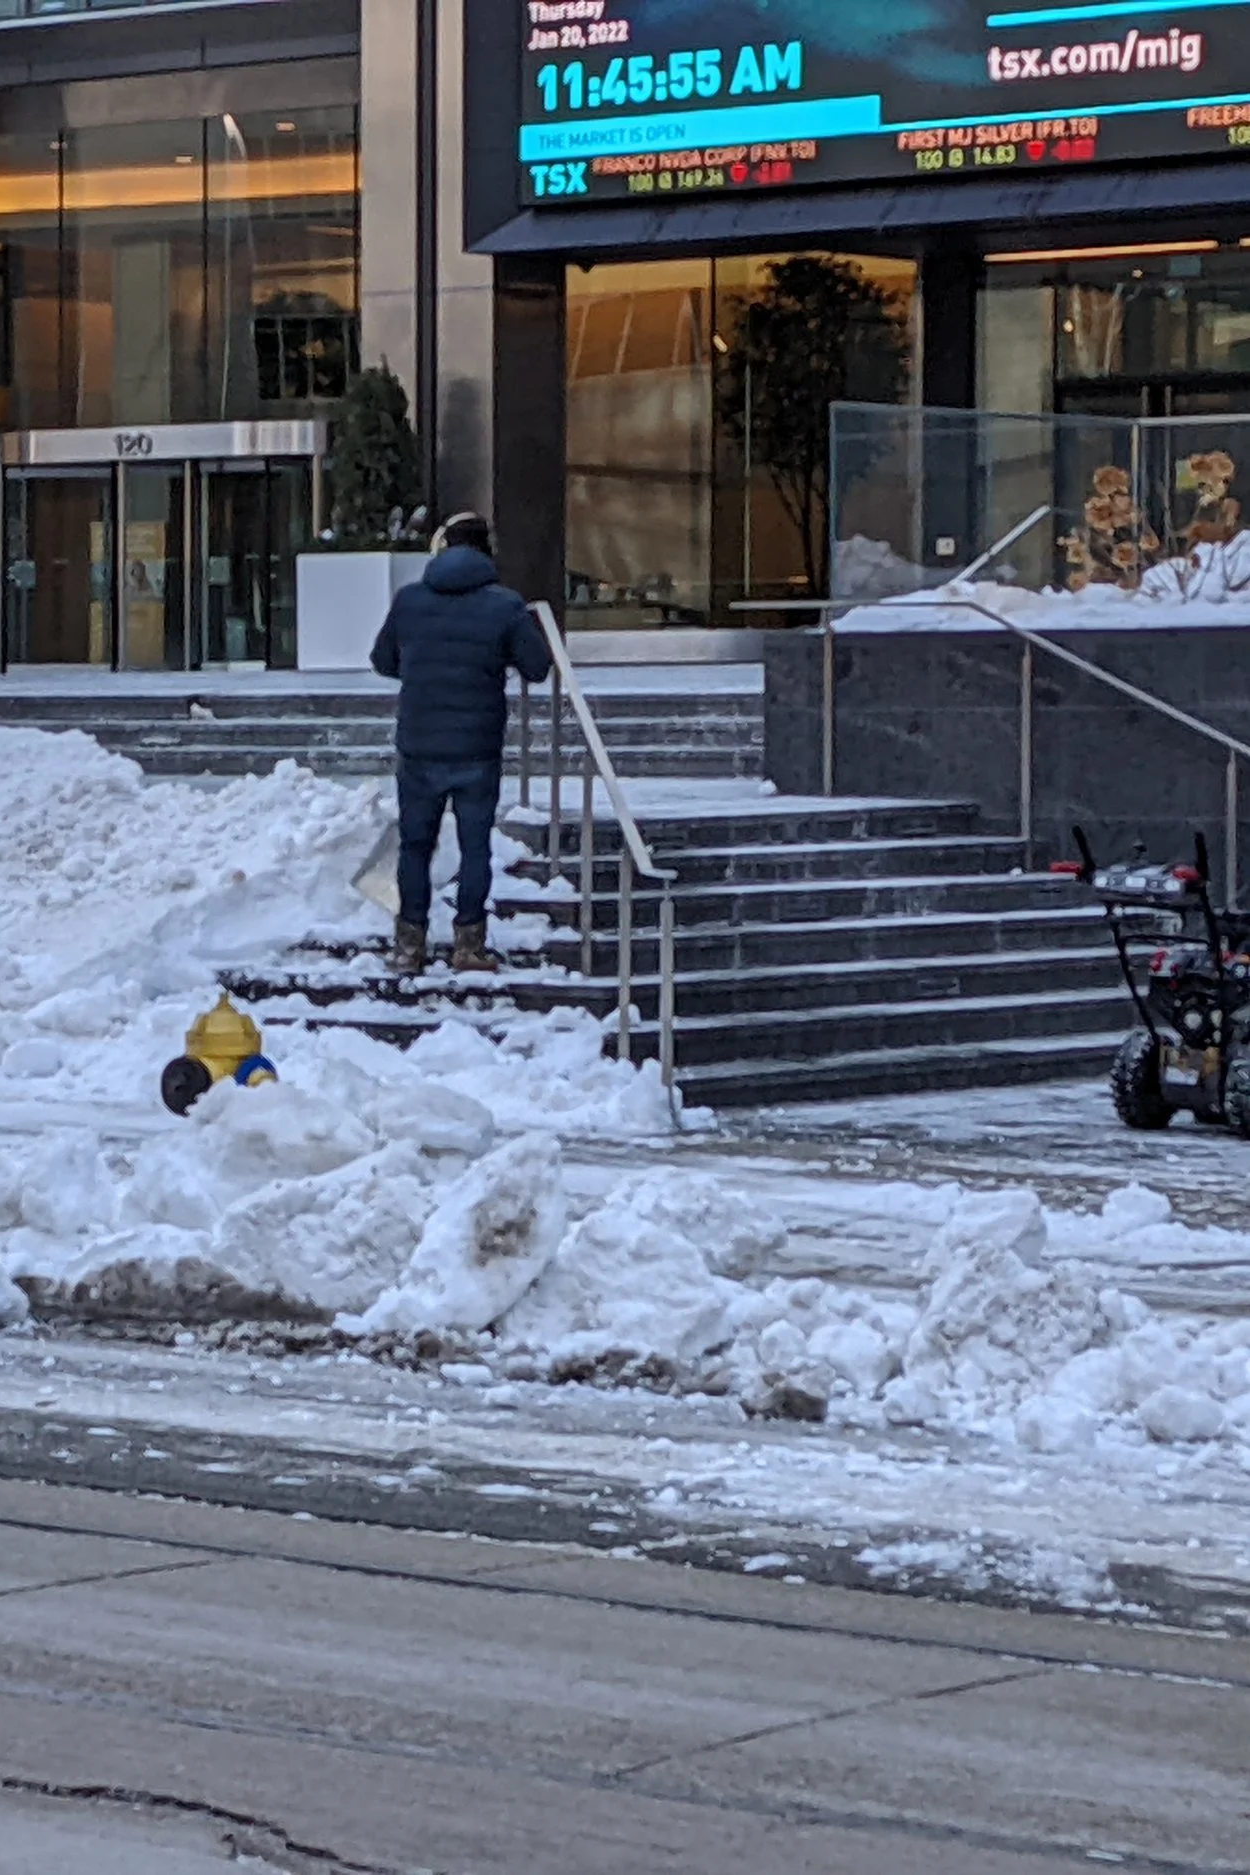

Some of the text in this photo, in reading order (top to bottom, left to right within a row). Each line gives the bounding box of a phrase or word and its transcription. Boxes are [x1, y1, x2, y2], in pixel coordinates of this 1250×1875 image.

[528, 0, 604, 23] Thursday
[528, 20, 629, 50] Jan 20, 2022
[988, 29, 1202, 81] tsx.com/mig
[537, 40, 801, 110] 11:45:55 AM
[538, 124, 686, 150] THE MARKET IS OPEN
[898, 128, 945, 149] FIRST
[975, 121, 1034, 144] SILVER
[529, 161, 588, 197] TSX
[114, 433, 153, 457] 120
